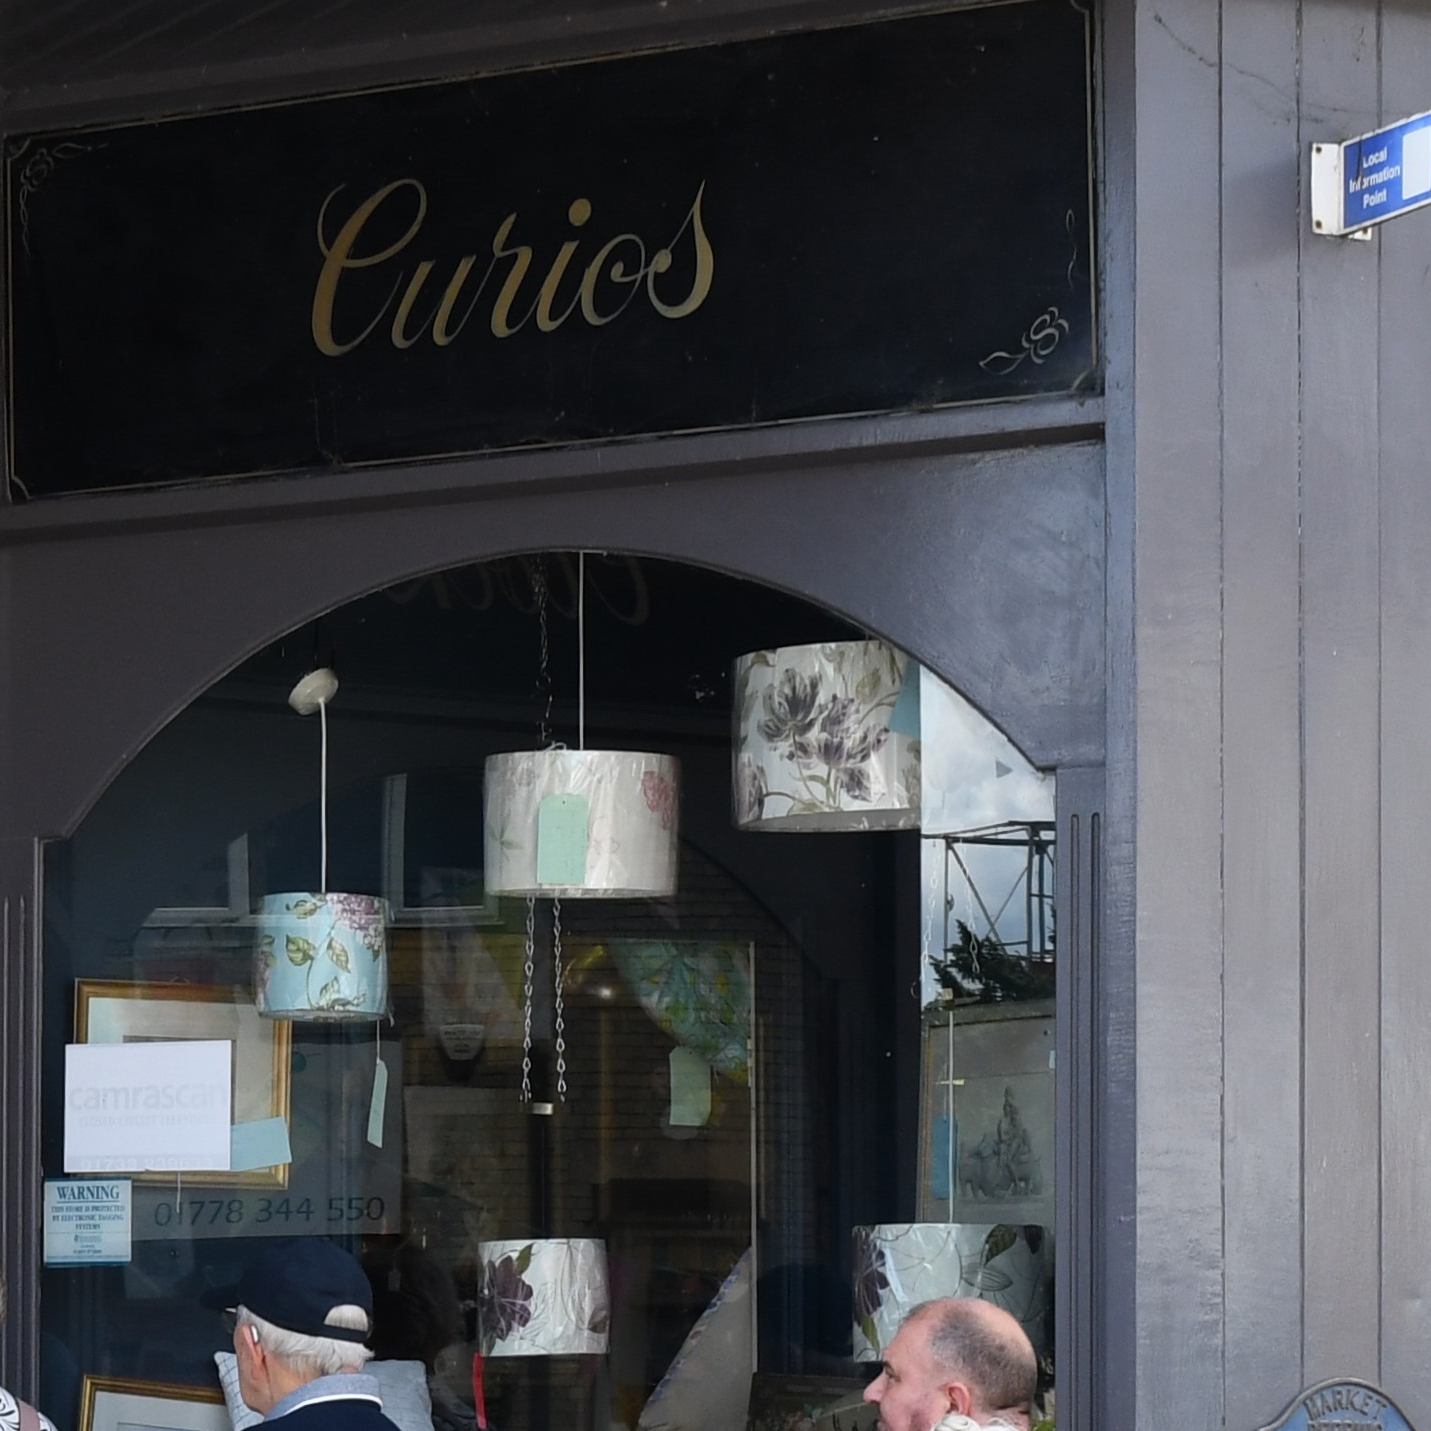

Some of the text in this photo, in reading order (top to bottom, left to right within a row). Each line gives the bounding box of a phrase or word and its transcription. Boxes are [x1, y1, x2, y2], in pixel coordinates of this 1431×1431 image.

[1363, 146, 1388, 168] Local
[1349, 165, 1401, 193] Information
[1363, 188, 1387, 209] Point
[312, 179, 714, 357] Curios
[56, 1185, 120, 1201] WARNING
[61, 1214, 97, 1222] ELECTRONIC
[98, 1213, 125, 1222] TAGGING
[65, 1205, 83, 1213] STORE
[91, 1204, 126, 1213] PROTECTED
[254, 1197, 316, 1224] 344
[327, 1196, 386, 1222] 550
[1303, 1389, 1388, 1420] MARKET
